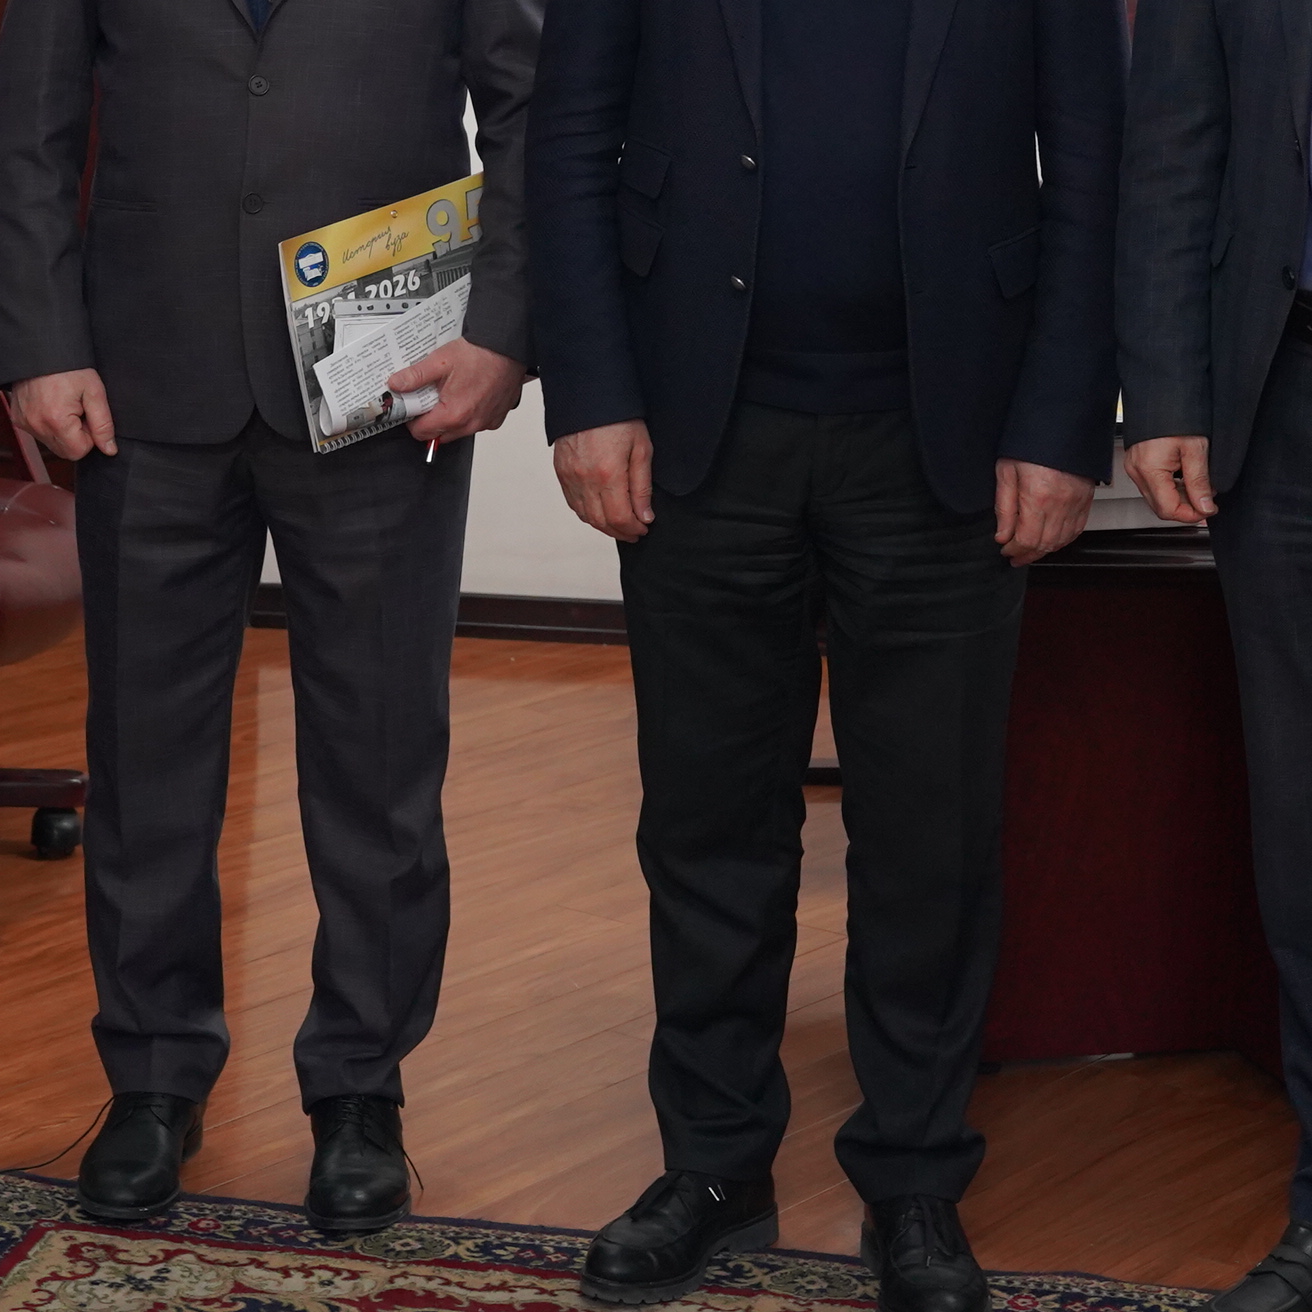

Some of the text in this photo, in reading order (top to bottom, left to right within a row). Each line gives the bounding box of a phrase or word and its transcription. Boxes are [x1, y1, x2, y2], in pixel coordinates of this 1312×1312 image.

[342, 225, 392, 264] История
[385, 231, 409, 256] вуза
[304, 270, 421, 328] 192026
